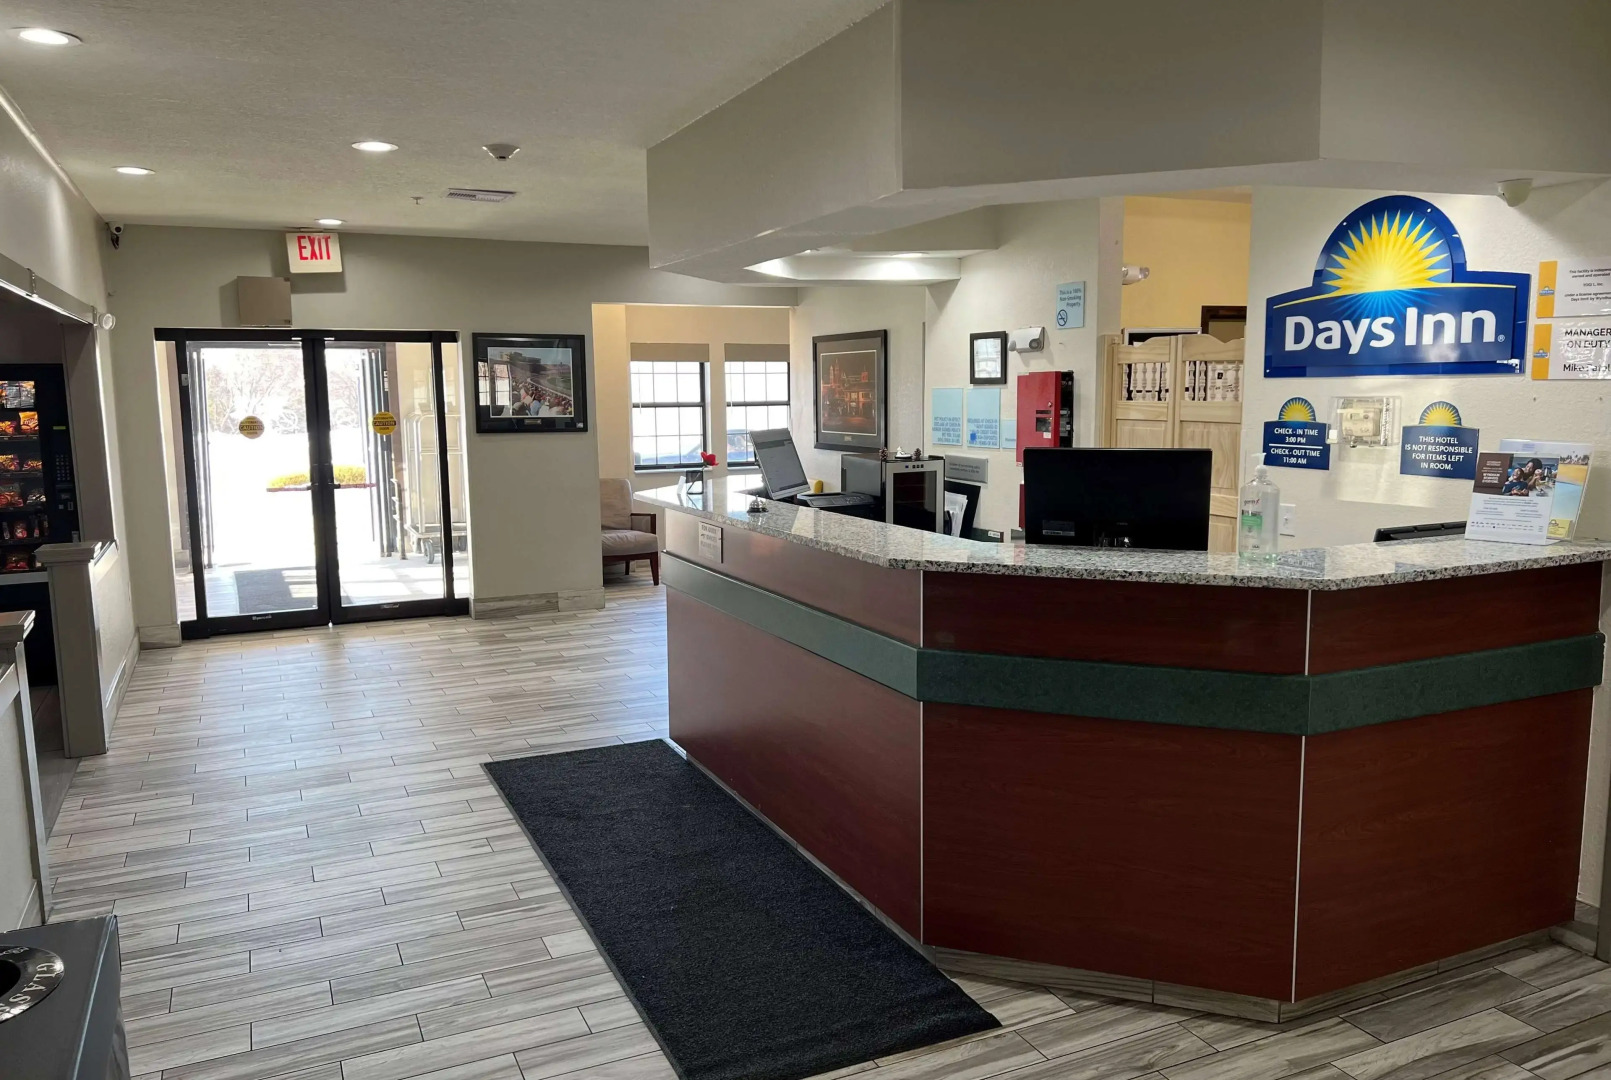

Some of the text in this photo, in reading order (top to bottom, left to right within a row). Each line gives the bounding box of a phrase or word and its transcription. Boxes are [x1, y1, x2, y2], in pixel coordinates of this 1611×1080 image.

[296, 235, 331, 260] EXIT
[1285, 316, 1395, 354] Days
[1565, 328, 1611, 336] MANAGER
[1428, 445, 1473, 453] RESPONSIBLE
